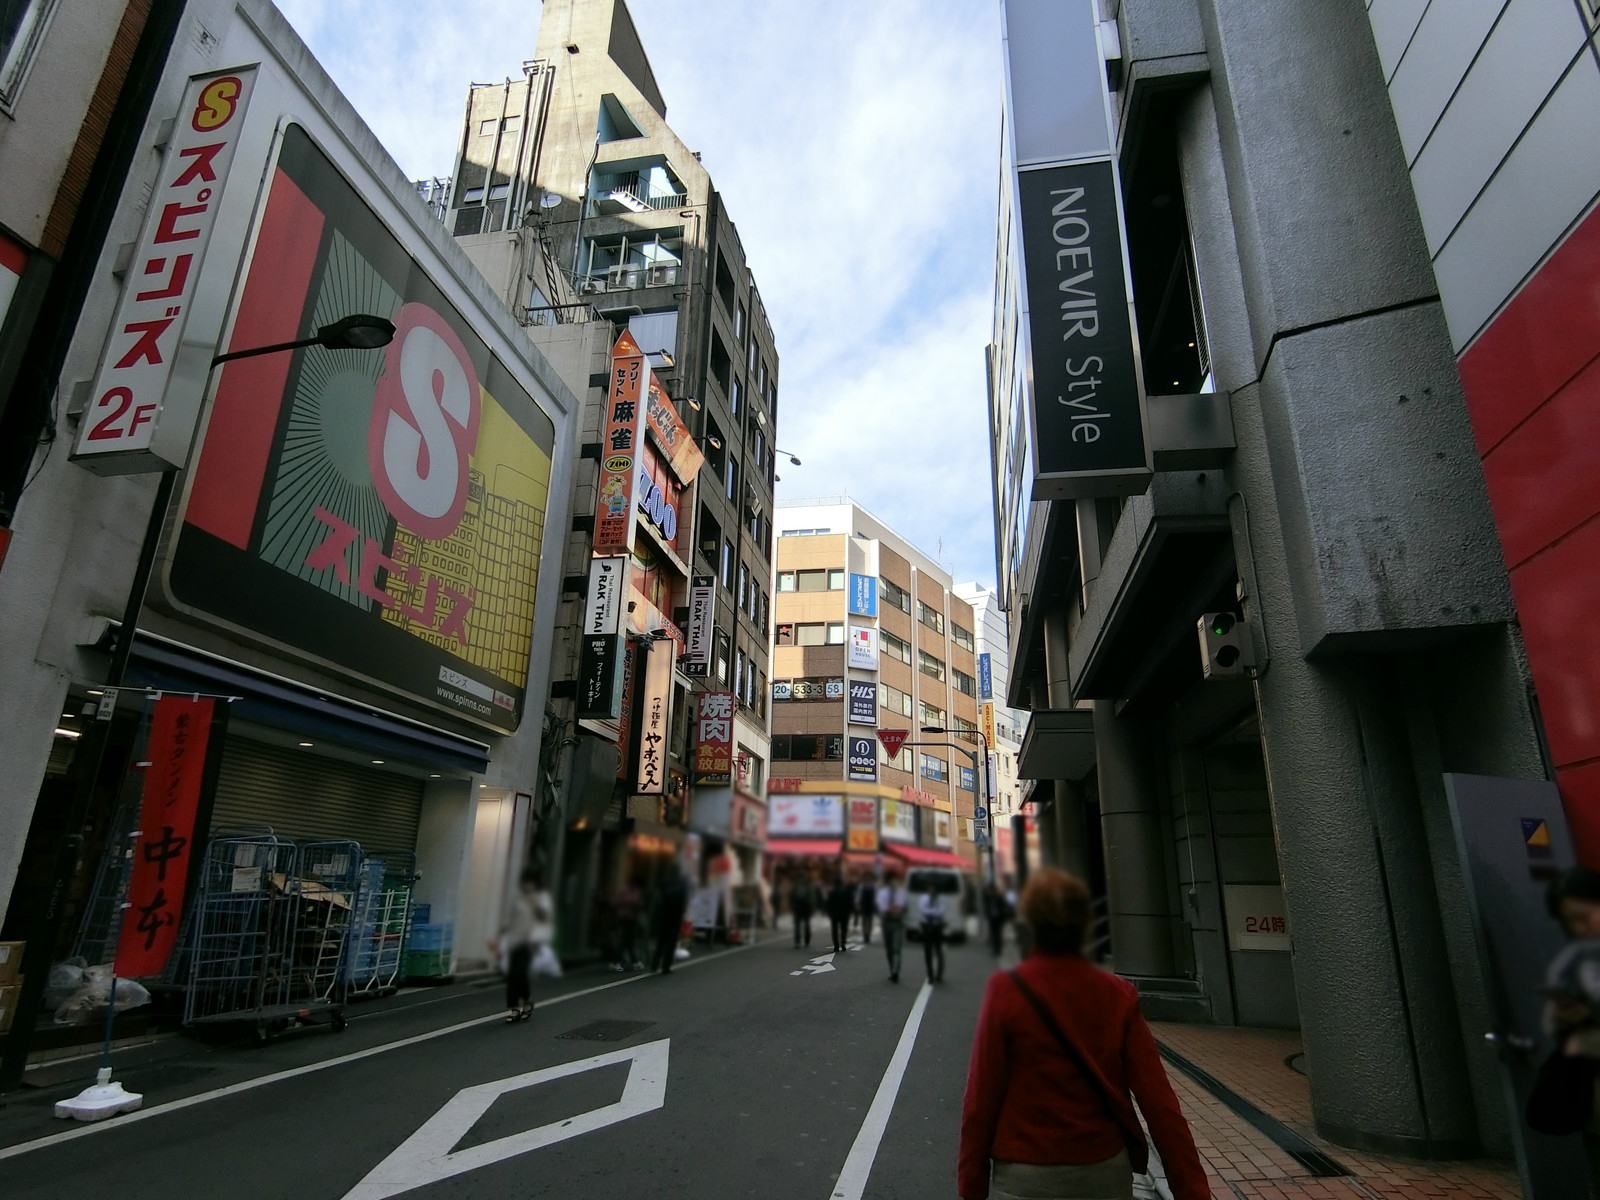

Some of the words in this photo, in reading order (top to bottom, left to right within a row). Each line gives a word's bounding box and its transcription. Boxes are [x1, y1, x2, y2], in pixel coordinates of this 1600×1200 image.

[113, 141, 228, 370] スピンズ
[1050, 187, 1099, 342] NOEVIR
[615, 368, 626, 397] セット
[630, 361, 640, 391] フリー
[88, 386, 158, 441] 2F
[1058, 355, 1111, 444] Style
[610, 400, 635, 452] 麻雀
[608, 460, 630, 469] ZOO
[304, 505, 477, 648] スピンズ
[598, 575, 607, 601] RAK
[593, 604, 604, 633] THAI
[693, 600, 702, 621] RAK
[691, 625, 701, 650] THAI
[689, 664, 704, 673] 2F
[436, 686, 492, 717] www.spinns.com
[827, 684, 839, 693] 58
[850, 685, 876, 700] HIS
[699, 693, 732, 743] 焼肉
[698, 744, 729, 757] 食べ
[883, 735, 902, 743] 止まれ
[697, 757, 729, 771] 放題
[137, 825, 187, 951] 中本
[1245, 916, 1285, 933] 24時
